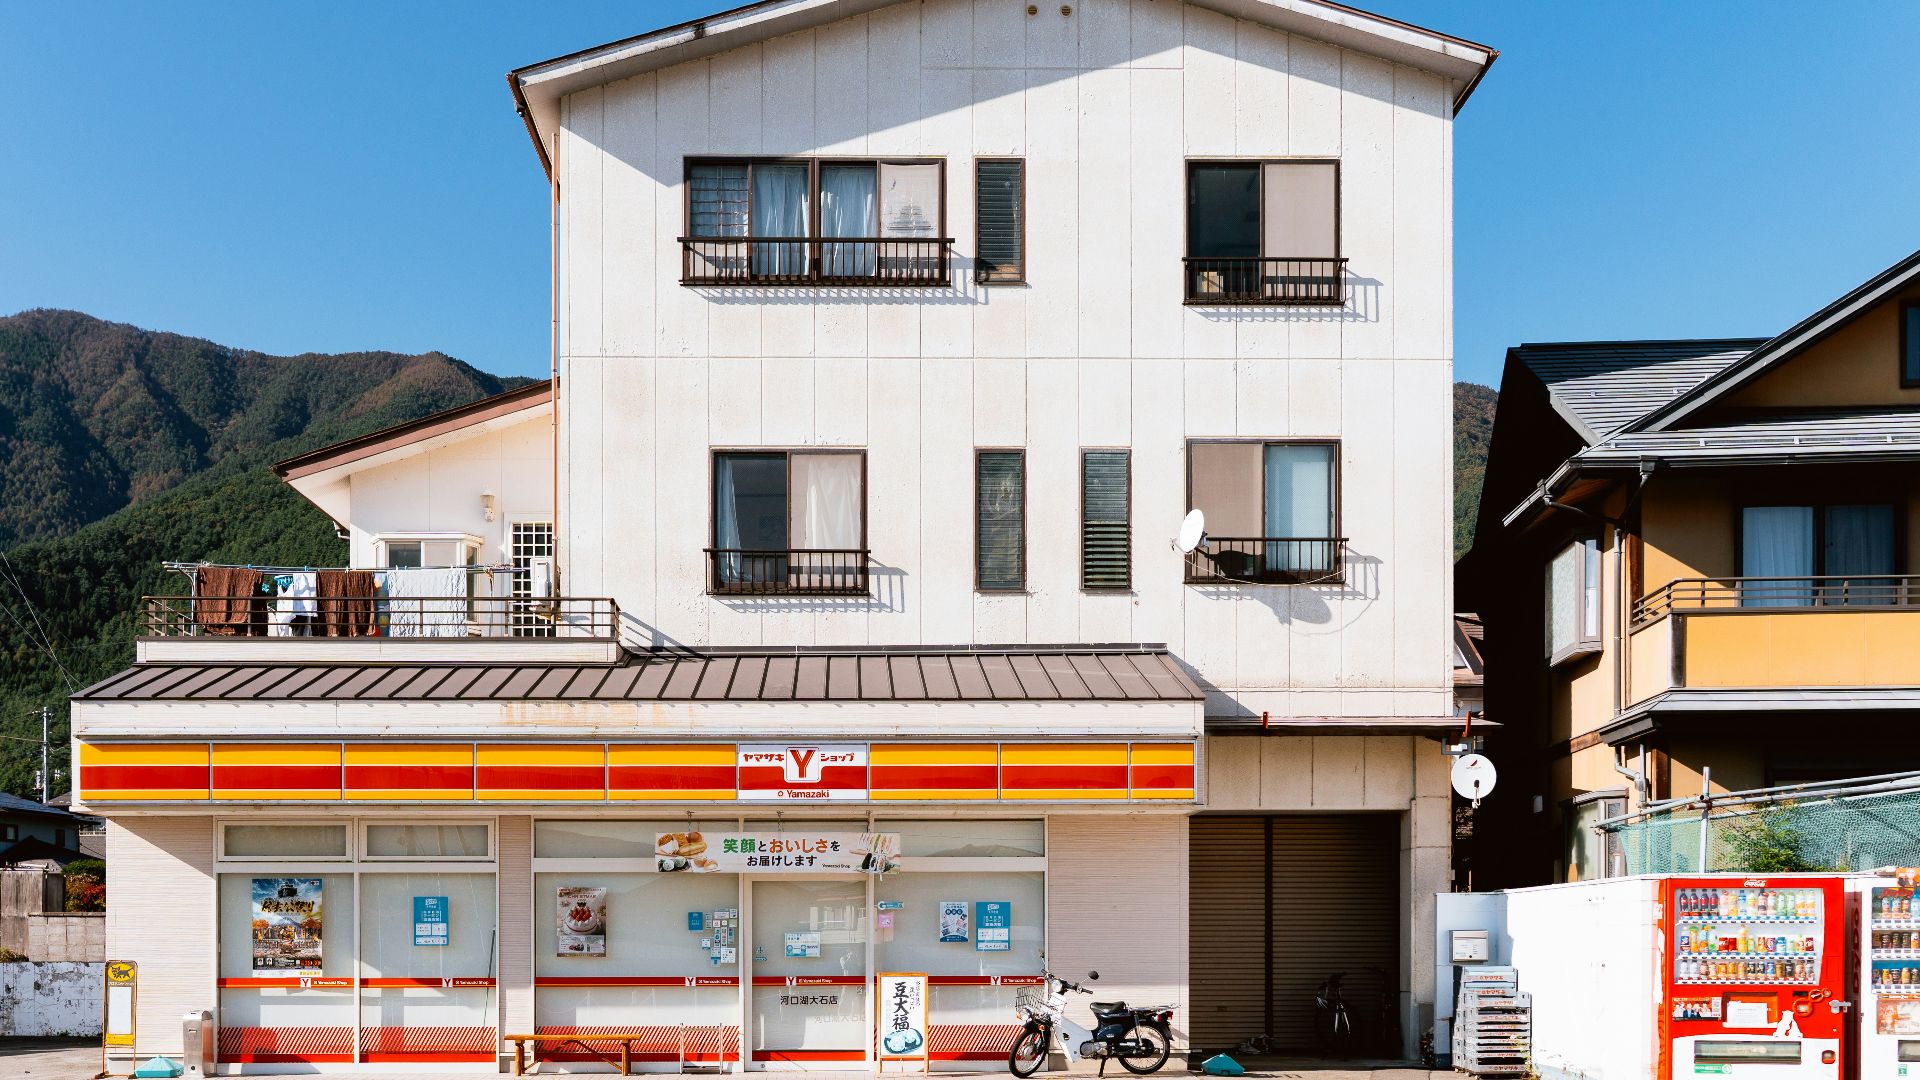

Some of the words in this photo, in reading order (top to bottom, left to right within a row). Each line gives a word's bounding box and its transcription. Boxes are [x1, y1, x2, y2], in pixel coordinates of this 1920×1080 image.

[743, 752, 785, 763] ヤマザキ
[789, 749, 816, 779] Y
[820, 752, 855, 762] ショップ
[786, 789, 830, 798] Yamazaki
[723, 837, 841, 855] 笑顔とおいしさを
[747, 855, 819, 867] お届けします
[780, 995, 839, 1006] 河口湖大石店
[891, 981, 910, 1031] 豆大福
